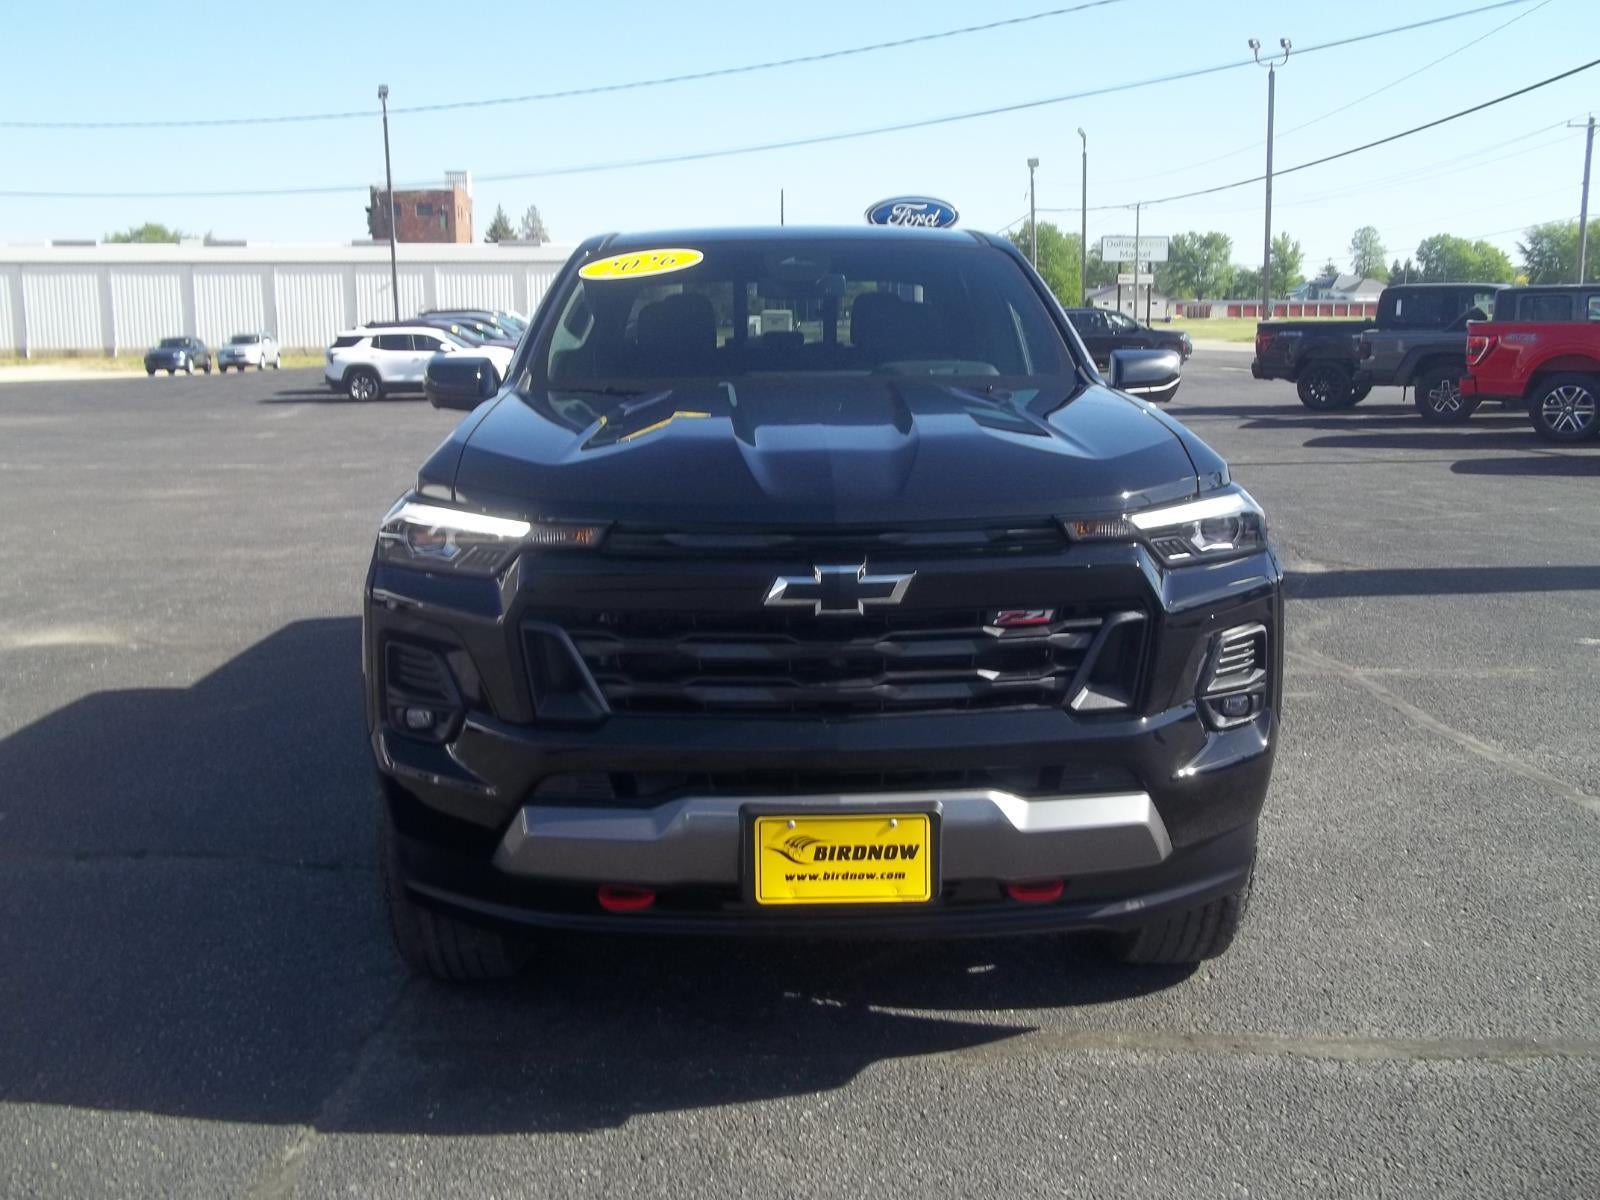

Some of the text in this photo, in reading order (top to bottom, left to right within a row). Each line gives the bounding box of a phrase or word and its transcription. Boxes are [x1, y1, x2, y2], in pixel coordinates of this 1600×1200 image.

[887, 203, 941, 226] Ford
[813, 844, 920, 862] BIRDNOW
[785, 871, 906, 882] www.birdnow.com
